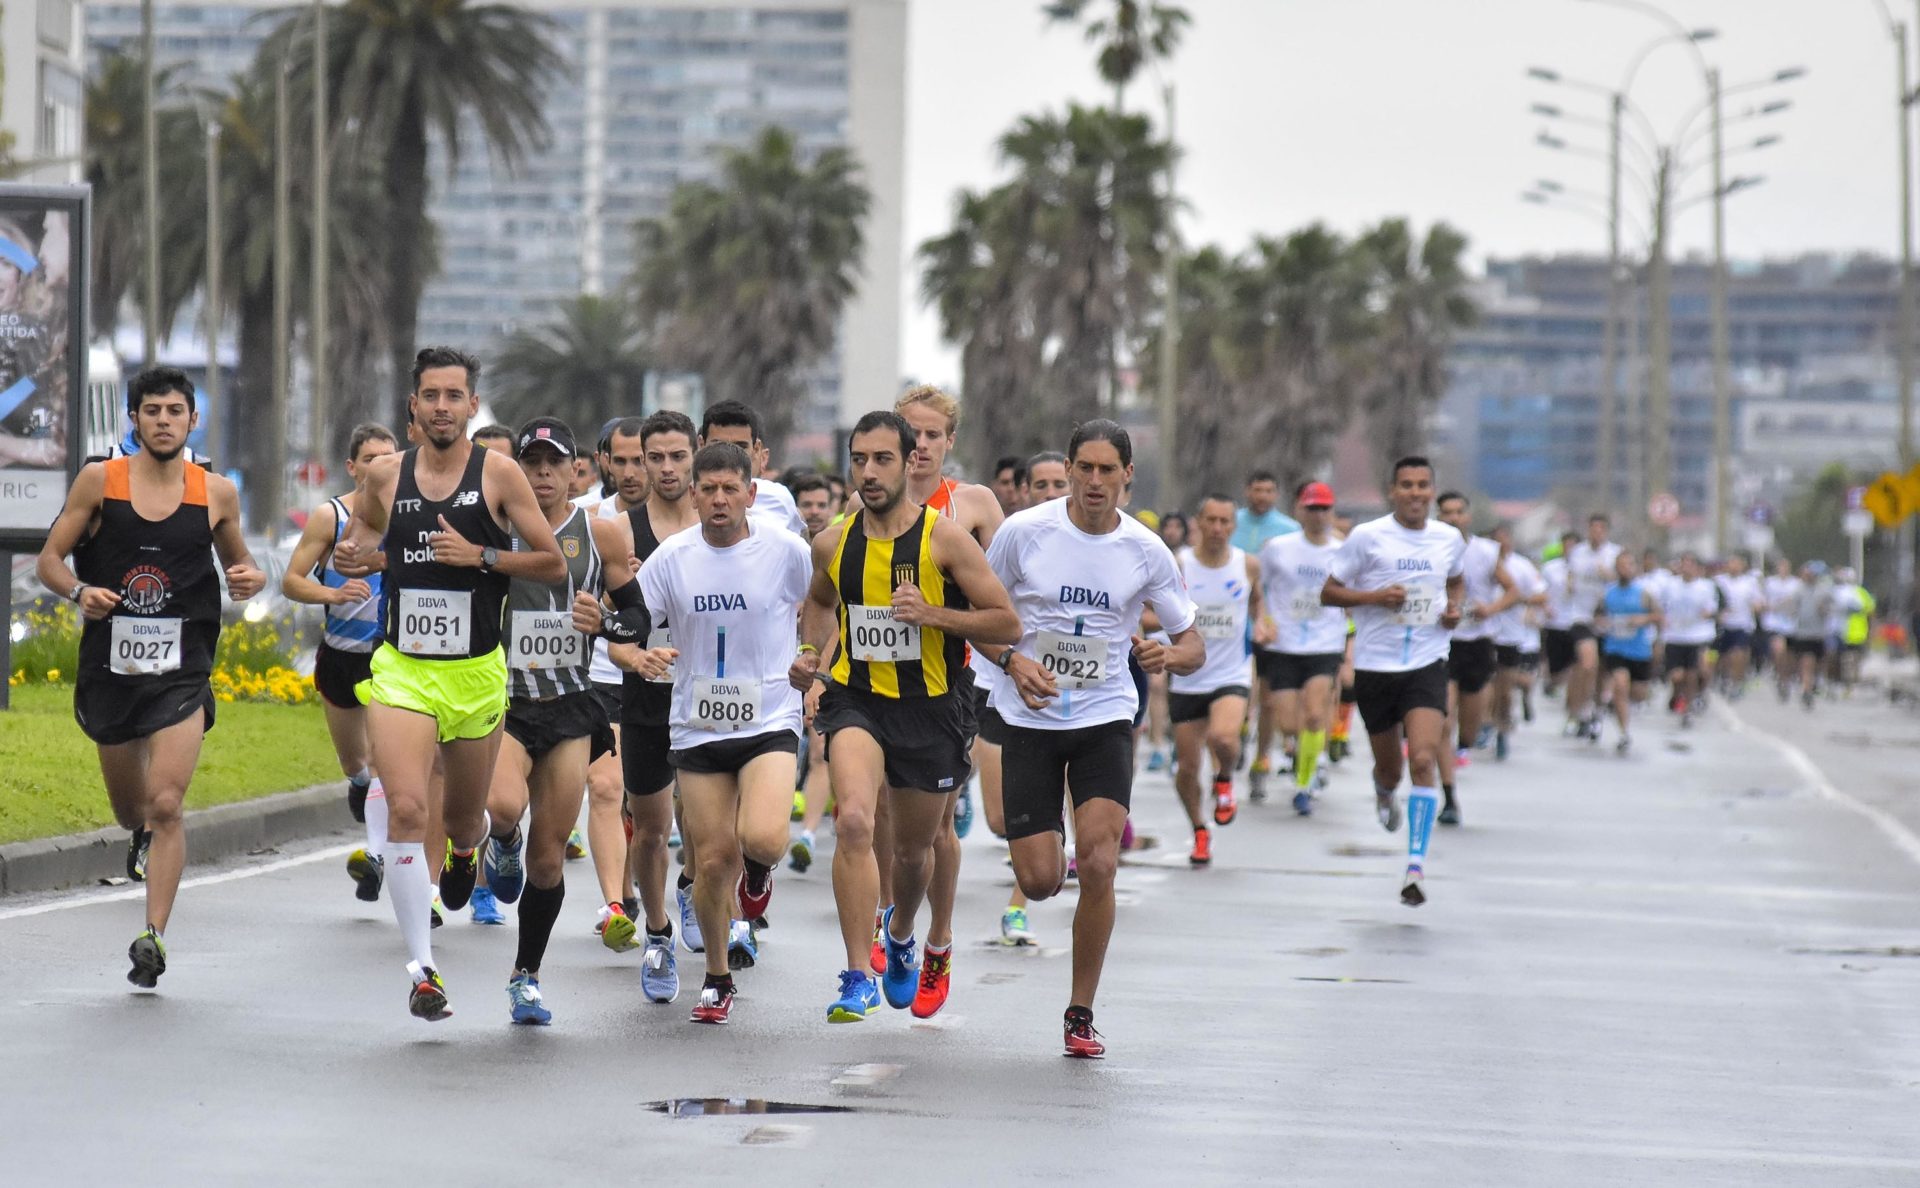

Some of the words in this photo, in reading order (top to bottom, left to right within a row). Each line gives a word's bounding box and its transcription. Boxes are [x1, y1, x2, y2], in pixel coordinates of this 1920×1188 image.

[396, 498, 422, 514] TTR
[1397, 557, 1433, 571] BBVA
[417, 597, 448, 609] BBVA
[693, 593, 748, 613] BBVA
[1059, 585, 1111, 609] BBVA
[132, 624, 161, 635] BBVA
[405, 613, 461, 637] 0051
[534, 618, 563, 630] BBVA
[519, 634, 576, 655] 0003
[856, 625, 910, 648] 0001
[118, 639, 174, 661] 0027
[1057, 641, 1087, 654] BBVA
[1042, 653, 1099, 680] 0022
[711, 684, 741, 696] BBVA
[698, 699, 755, 722] 0808
